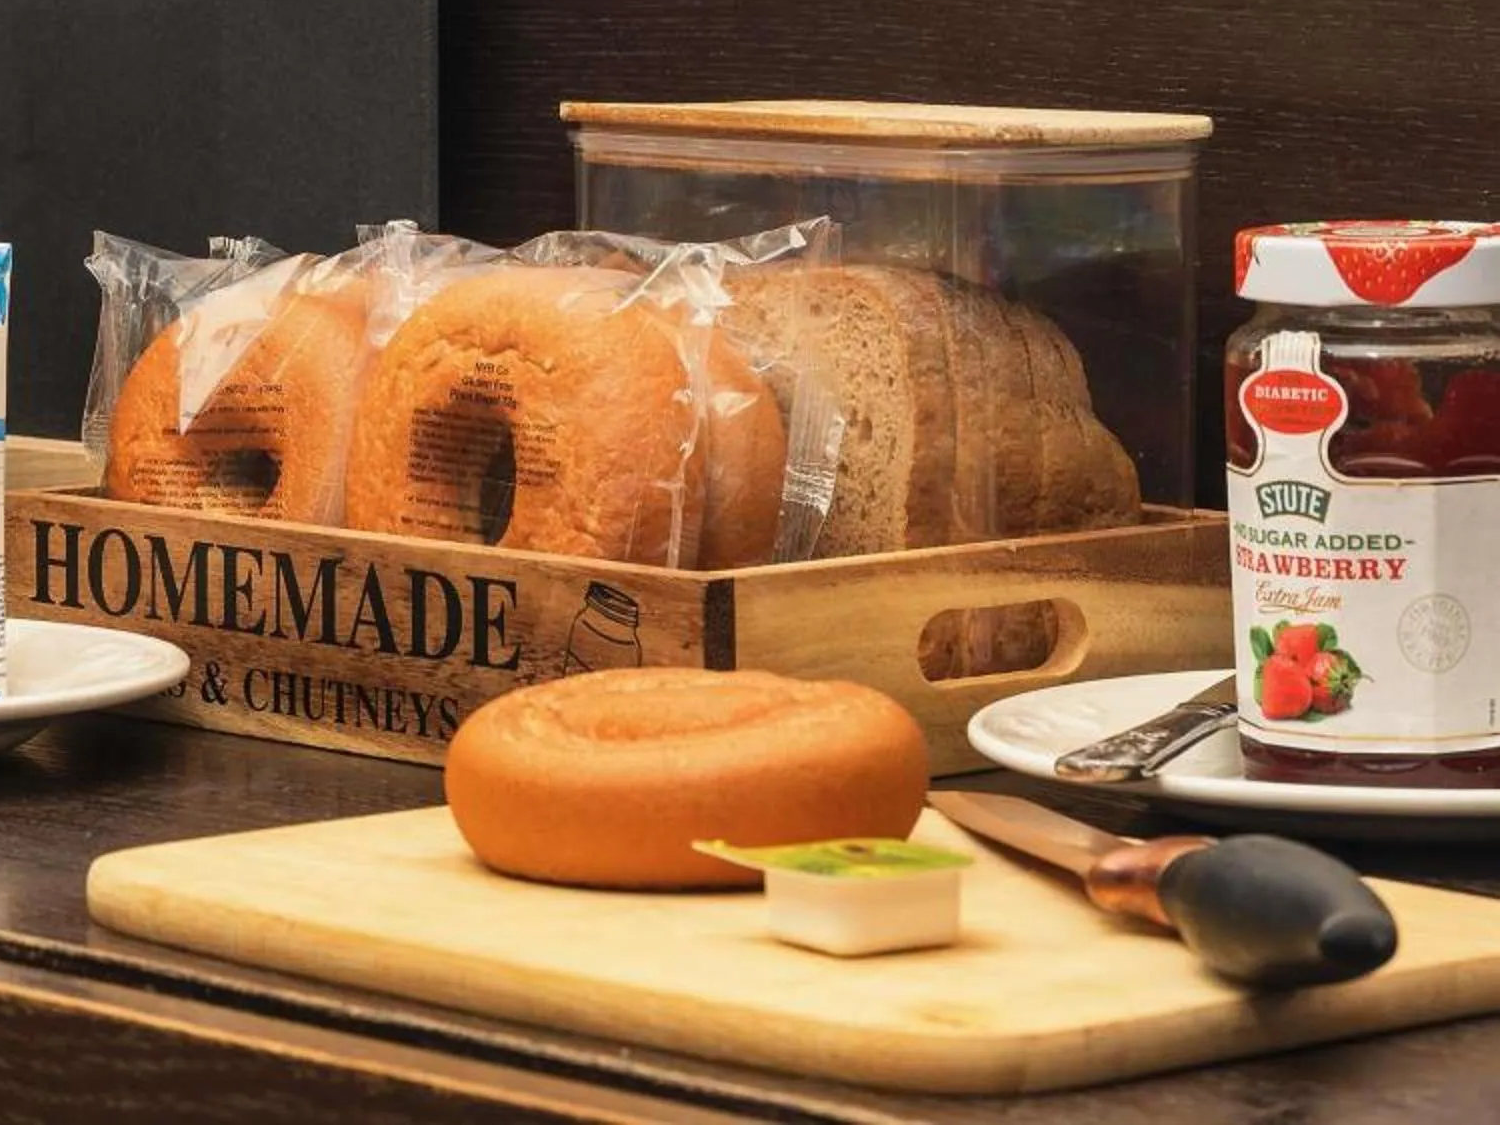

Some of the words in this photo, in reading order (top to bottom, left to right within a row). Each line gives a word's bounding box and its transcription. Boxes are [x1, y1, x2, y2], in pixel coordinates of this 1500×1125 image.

[1255, 386, 1330, 402] DIABETIC
[1259, 483, 1326, 519] STUTE
[1248, 527, 1308, 549] SUGAR
[1236, 543, 1408, 580] STRAWBERRY
[29, 518, 521, 673] HOMEMADE
[1255, 579, 1299, 605] Extra
[1300, 584, 1343, 610] Jam
[200, 661, 228, 706] &
[243, 668, 460, 741] CHUTNEYS
